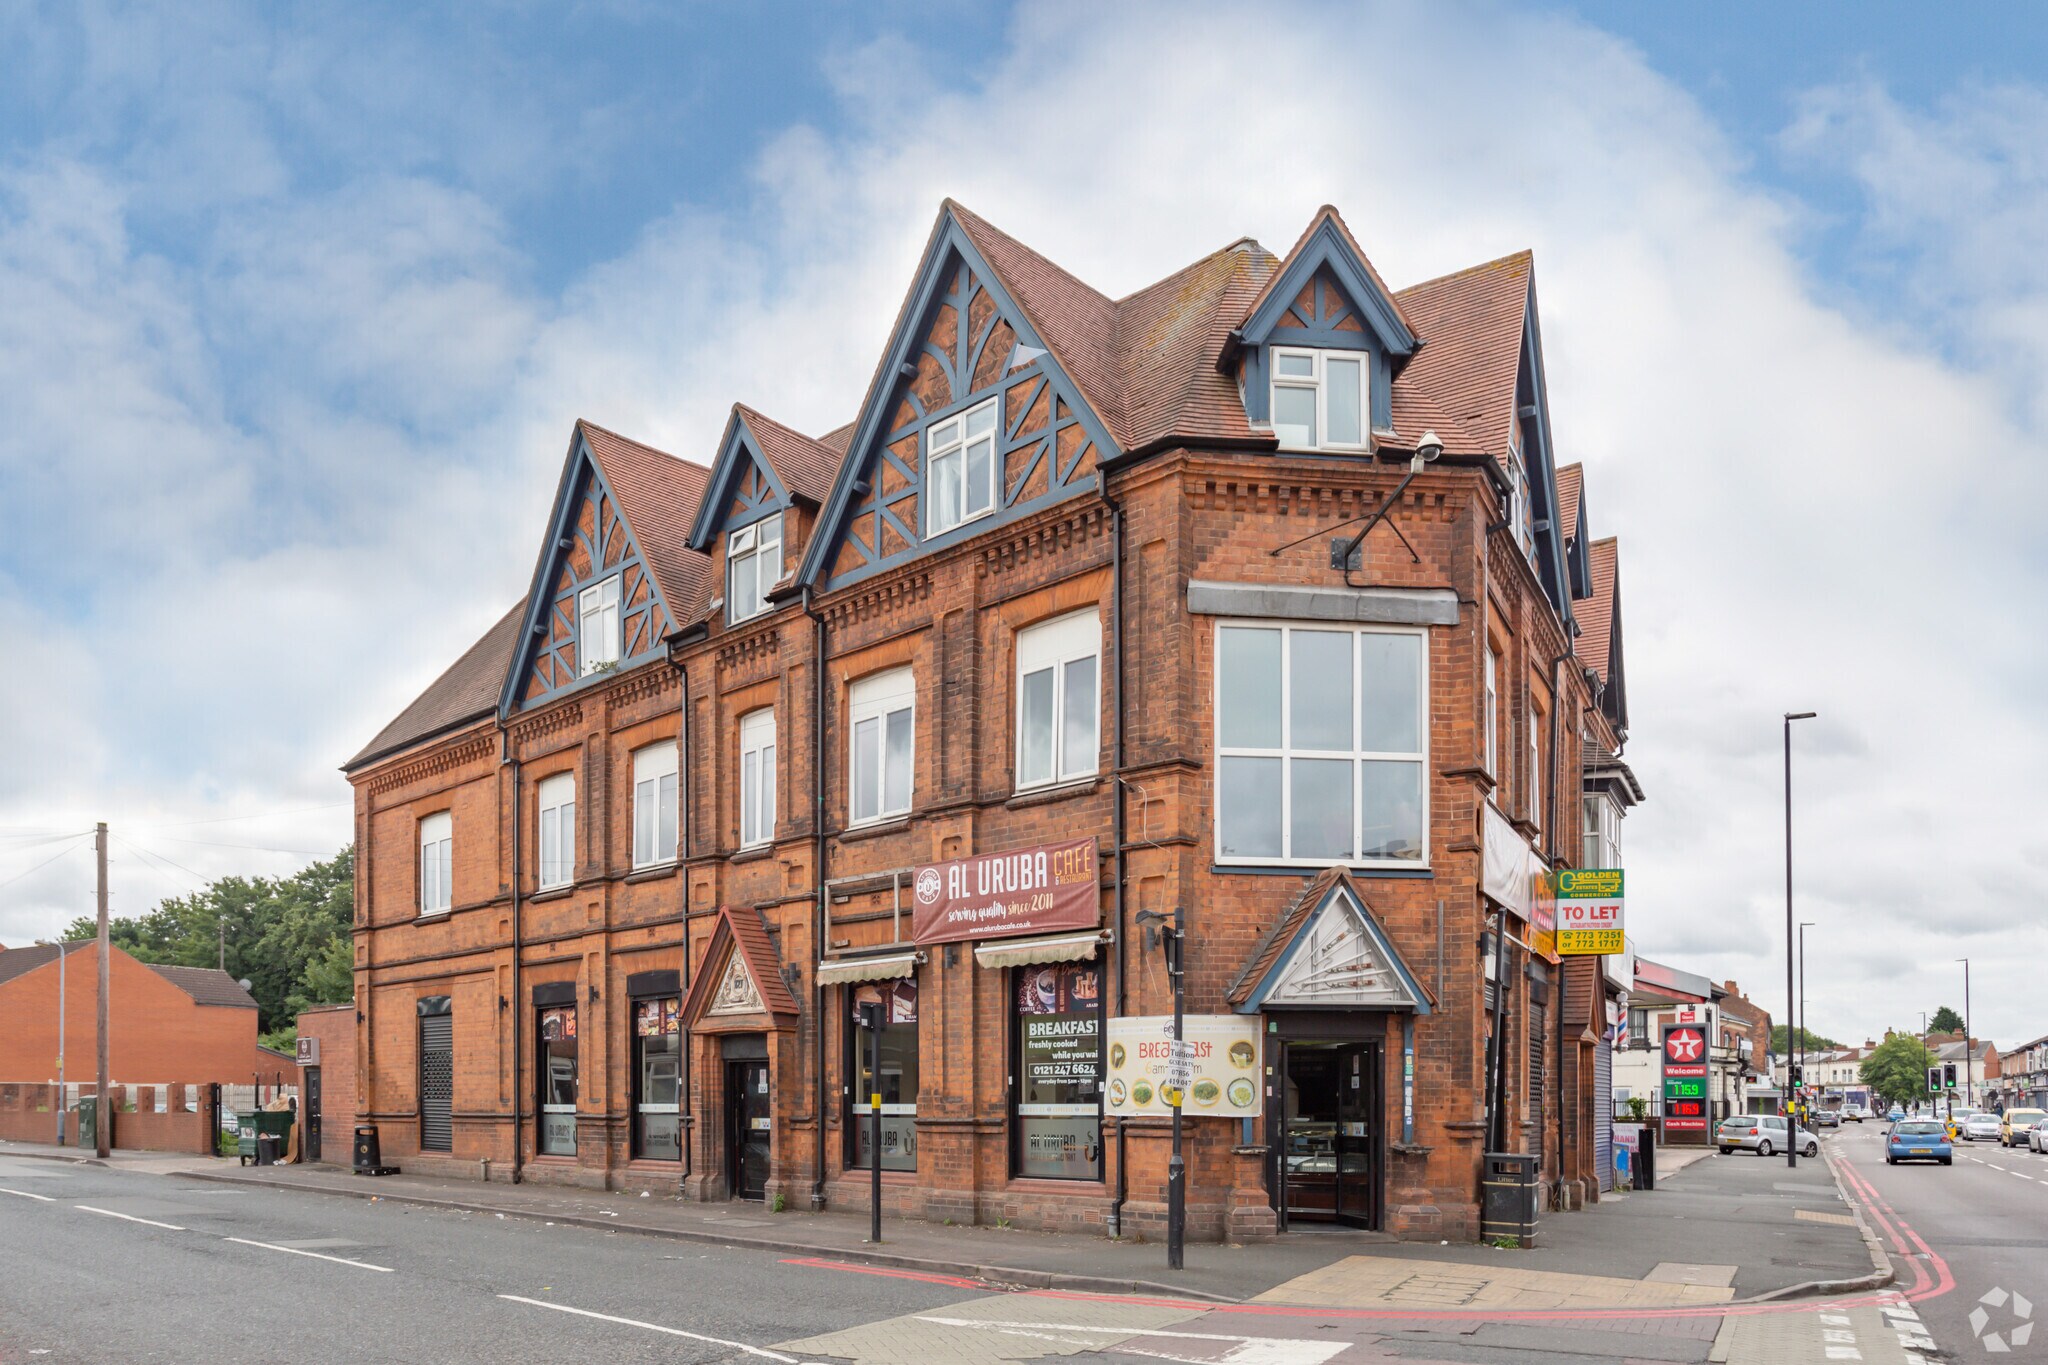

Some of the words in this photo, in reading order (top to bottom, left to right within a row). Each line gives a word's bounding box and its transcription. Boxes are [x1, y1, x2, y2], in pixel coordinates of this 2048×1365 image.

[949, 864, 970, 899] AL
[978, 852, 1048, 895] URUBA
[948, 910, 977, 922] serving
[978, 901, 1007, 919] quality
[1008, 902, 1031, 915] since
[1031, 892, 1053, 912] 2011
[1563, 907, 1584, 920] TO
[1590, 906, 1619, 919] LET
[969, 921, 1031, 933] www.alurubacafe.co.uk
[1575, 931, 1594, 939] 773
[1597, 931, 1621, 939] 7351
[1575, 940, 1594, 948] 772
[1598, 940, 1620, 948] 1717
[1029, 1020, 1099, 1036] BREAKFAST
[1029, 1040, 1052, 1050] freshly
[1053, 1039, 1078, 1048] cooked
[1052, 1051, 1071, 1059] while
[1085, 1050, 1099, 1058] wai
[1171, 1049, 1195, 1059] Tuition
[1033, 1065, 1054, 1075] 0121
[1054, 1065, 1071, 1076] 247
[1072, 1064, 1096, 1075] 6624
[1038, 1077, 1056, 1085] everyday
[862, 1130, 871, 1146] AL
